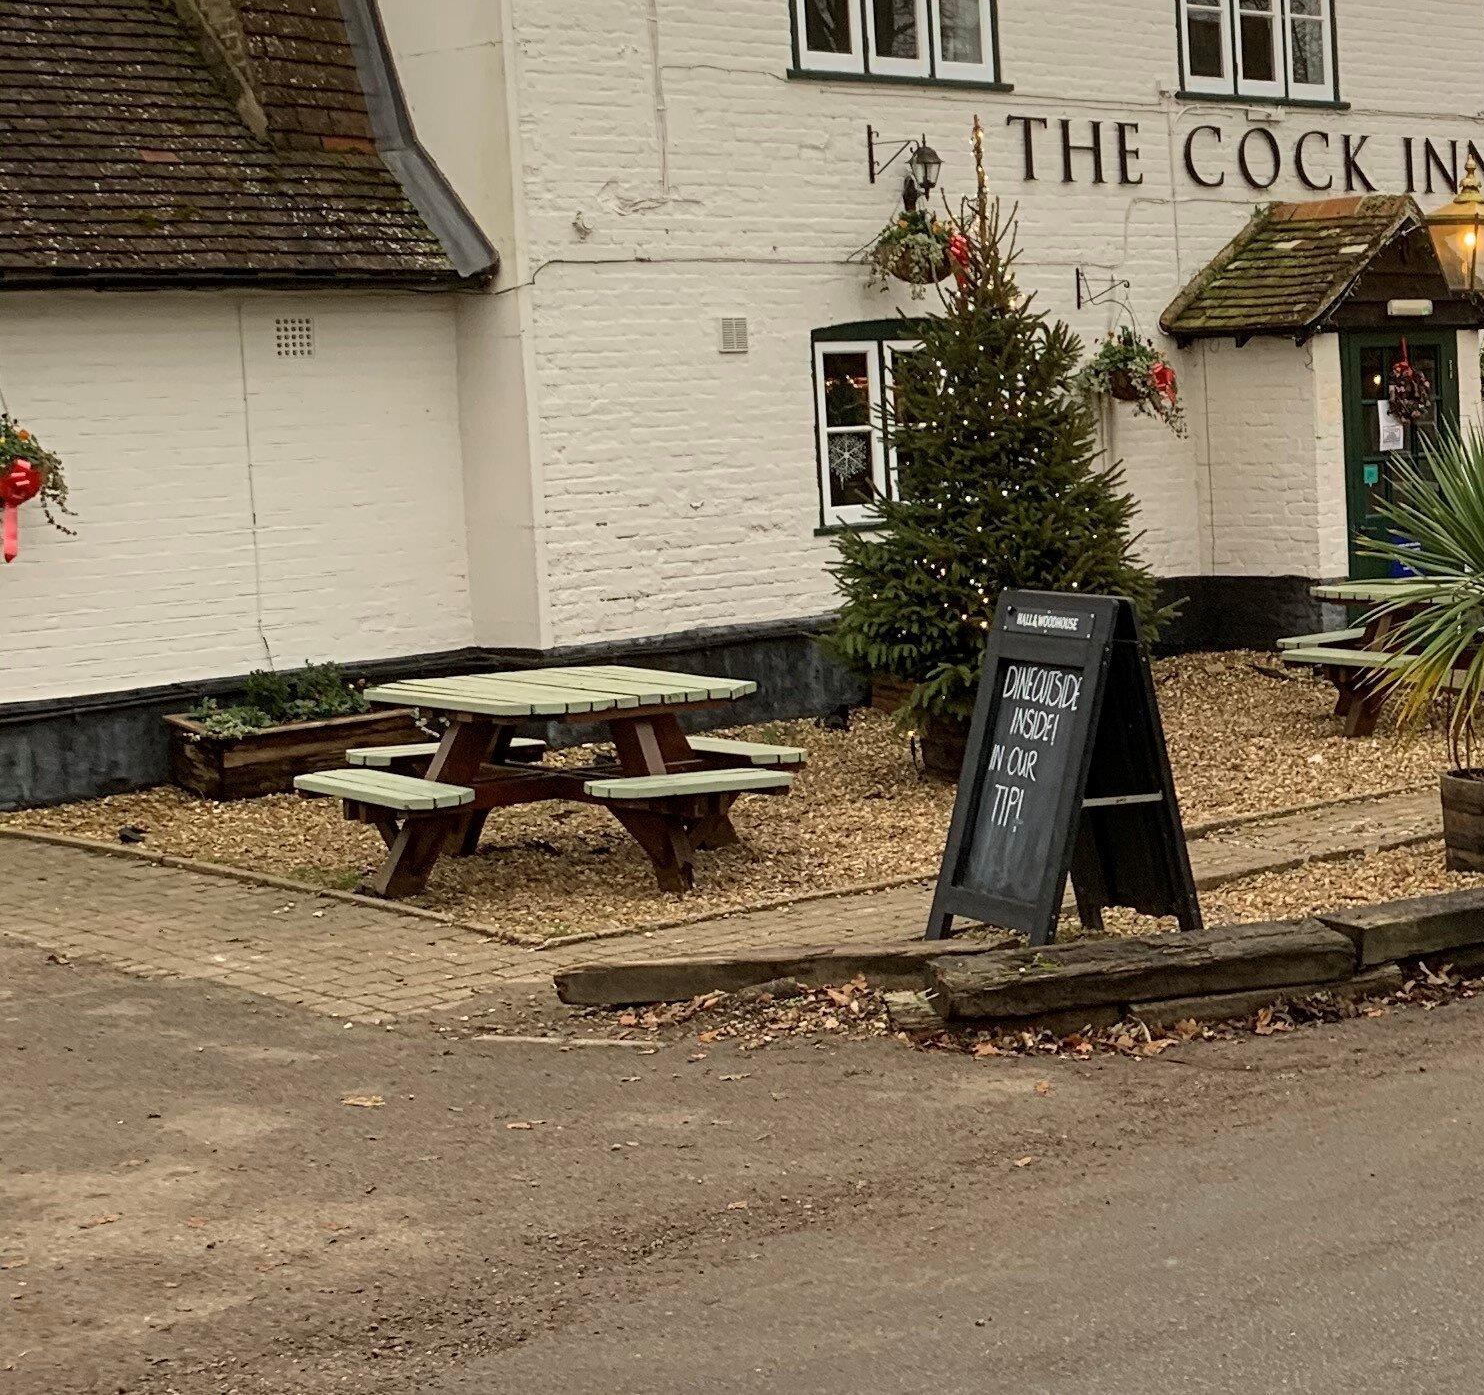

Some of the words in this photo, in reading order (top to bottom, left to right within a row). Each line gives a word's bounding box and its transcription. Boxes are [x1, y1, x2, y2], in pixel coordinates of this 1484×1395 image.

[1006, 114, 1144, 185] THE
[1184, 124, 1378, 193] COCK
[988, 744, 1006, 772] IN
[1007, 746, 1038, 782] OUR
